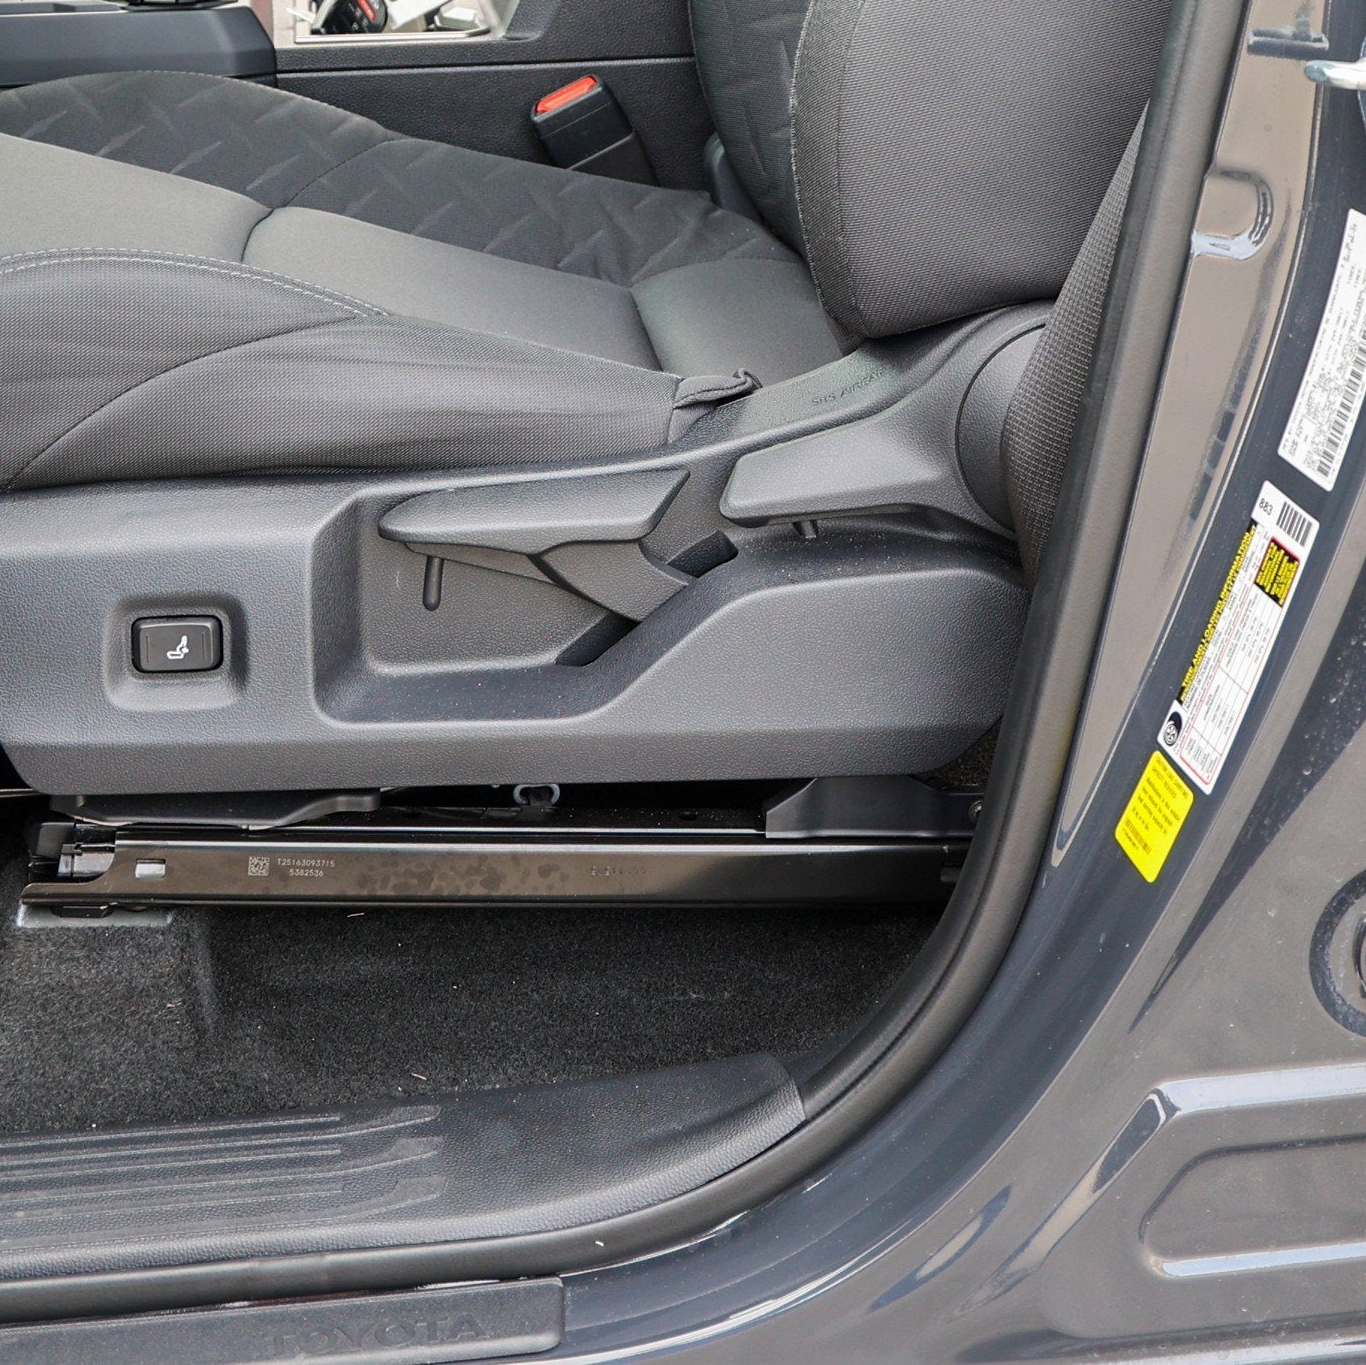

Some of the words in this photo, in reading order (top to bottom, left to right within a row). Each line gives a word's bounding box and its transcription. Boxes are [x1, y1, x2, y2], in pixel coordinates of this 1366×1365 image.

[1258, 497, 1274, 516] 883
[1220, 531, 1251, 598] INFORMATION
[262, 1311, 486, 1356] TOYOTA
